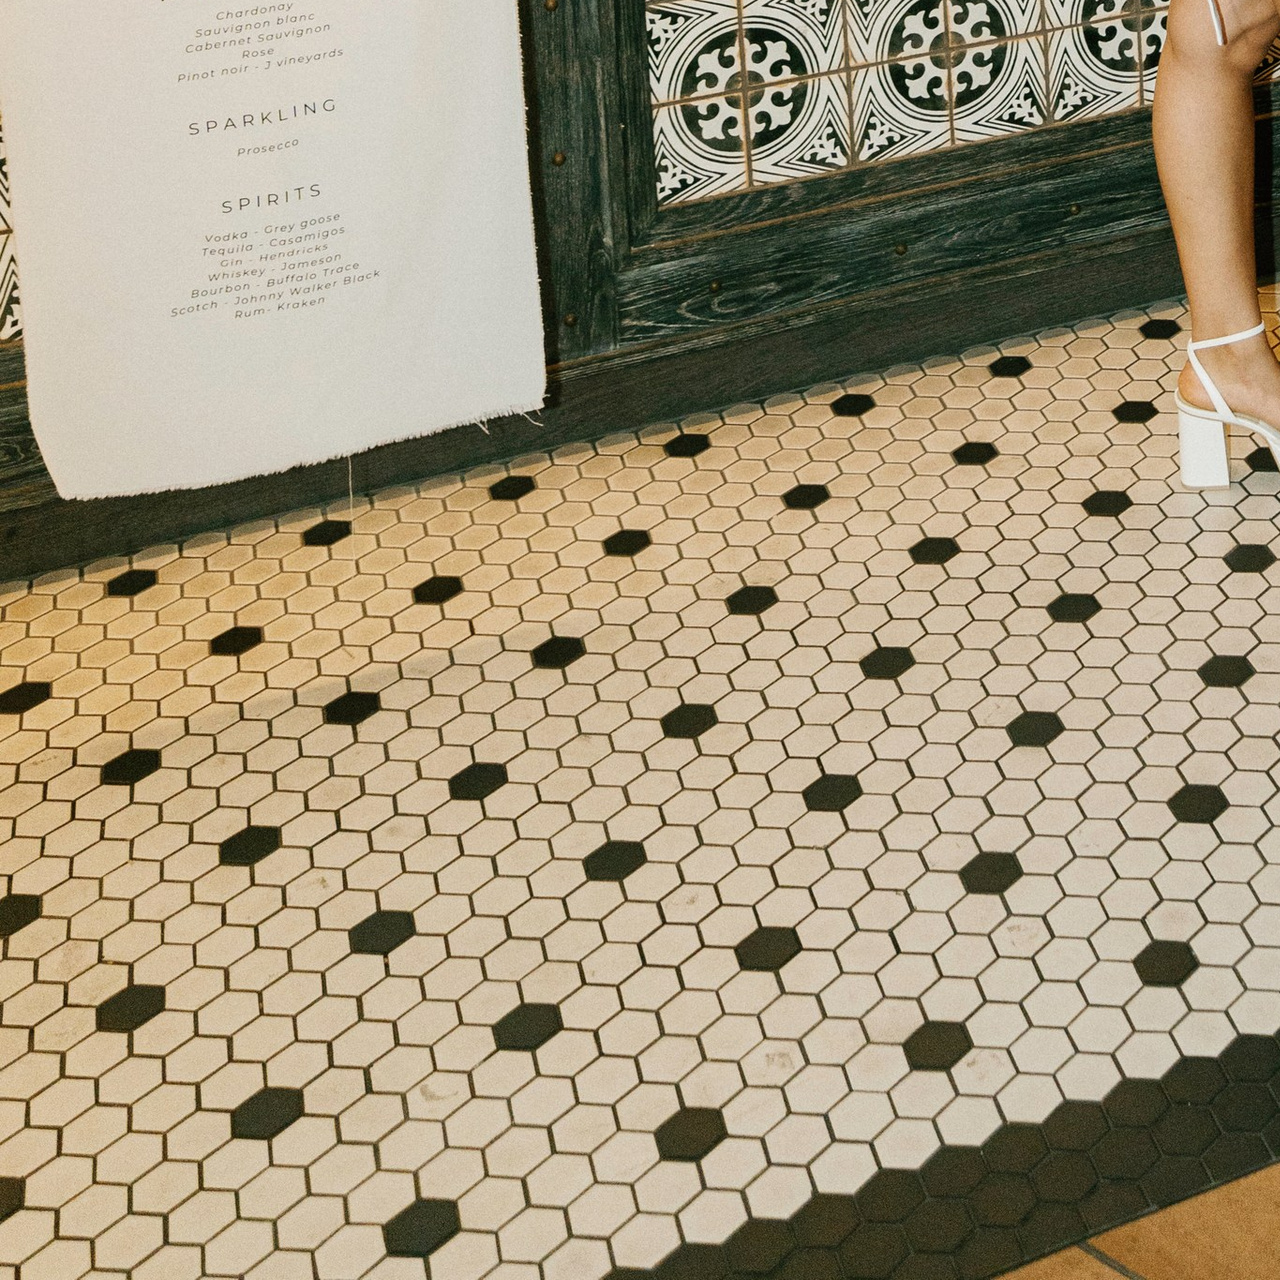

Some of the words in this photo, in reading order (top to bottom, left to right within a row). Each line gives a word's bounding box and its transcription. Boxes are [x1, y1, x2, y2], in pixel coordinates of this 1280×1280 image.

[195, 20, 271, 38] Sauvignon
[277, 13, 315, 25] blanc
[216, 1, 294, 21] Chardonay
[185, 36, 251, 54] Cabernet
[257, 24, 331, 42] Sauvignon
[242, 47, 275, 59] Rose
[177, 70, 215, 83] Pinot
[221, 65, 250, 76] noir
[264, 61, 271, 70] J
[277, 48, 344, 67] vineyards
[188, 99, 336, 136] SPARKLING
[237, 139, 299, 157] Prosecco
[221, 184, 321, 214] SPIRITS
[202, 244, 253, 257] Tequila
[269, 226, 346, 248] Casamigos
[205, 231, 248, 243] Vodka
[264, 223, 295, 234] Grey
[300, 213, 341, 230] goose
[208, 268, 266, 282] Whiskey
[281, 253, 342, 271] Jameson
[220, 258, 243, 268] Gin
[260, 243, 328, 261] Hendricks
[170, 300, 218, 318] Scotch
[234, 291, 285, 306] Johnny
[290, 280, 338, 296] Walker
[343, 270, 381, 286] Black
[191, 283, 251, 299] Bourbon
[266, 272, 317, 288] Buffalo
[323, 262, 360, 277] Trace
[277, 296, 325, 311] Kraken
